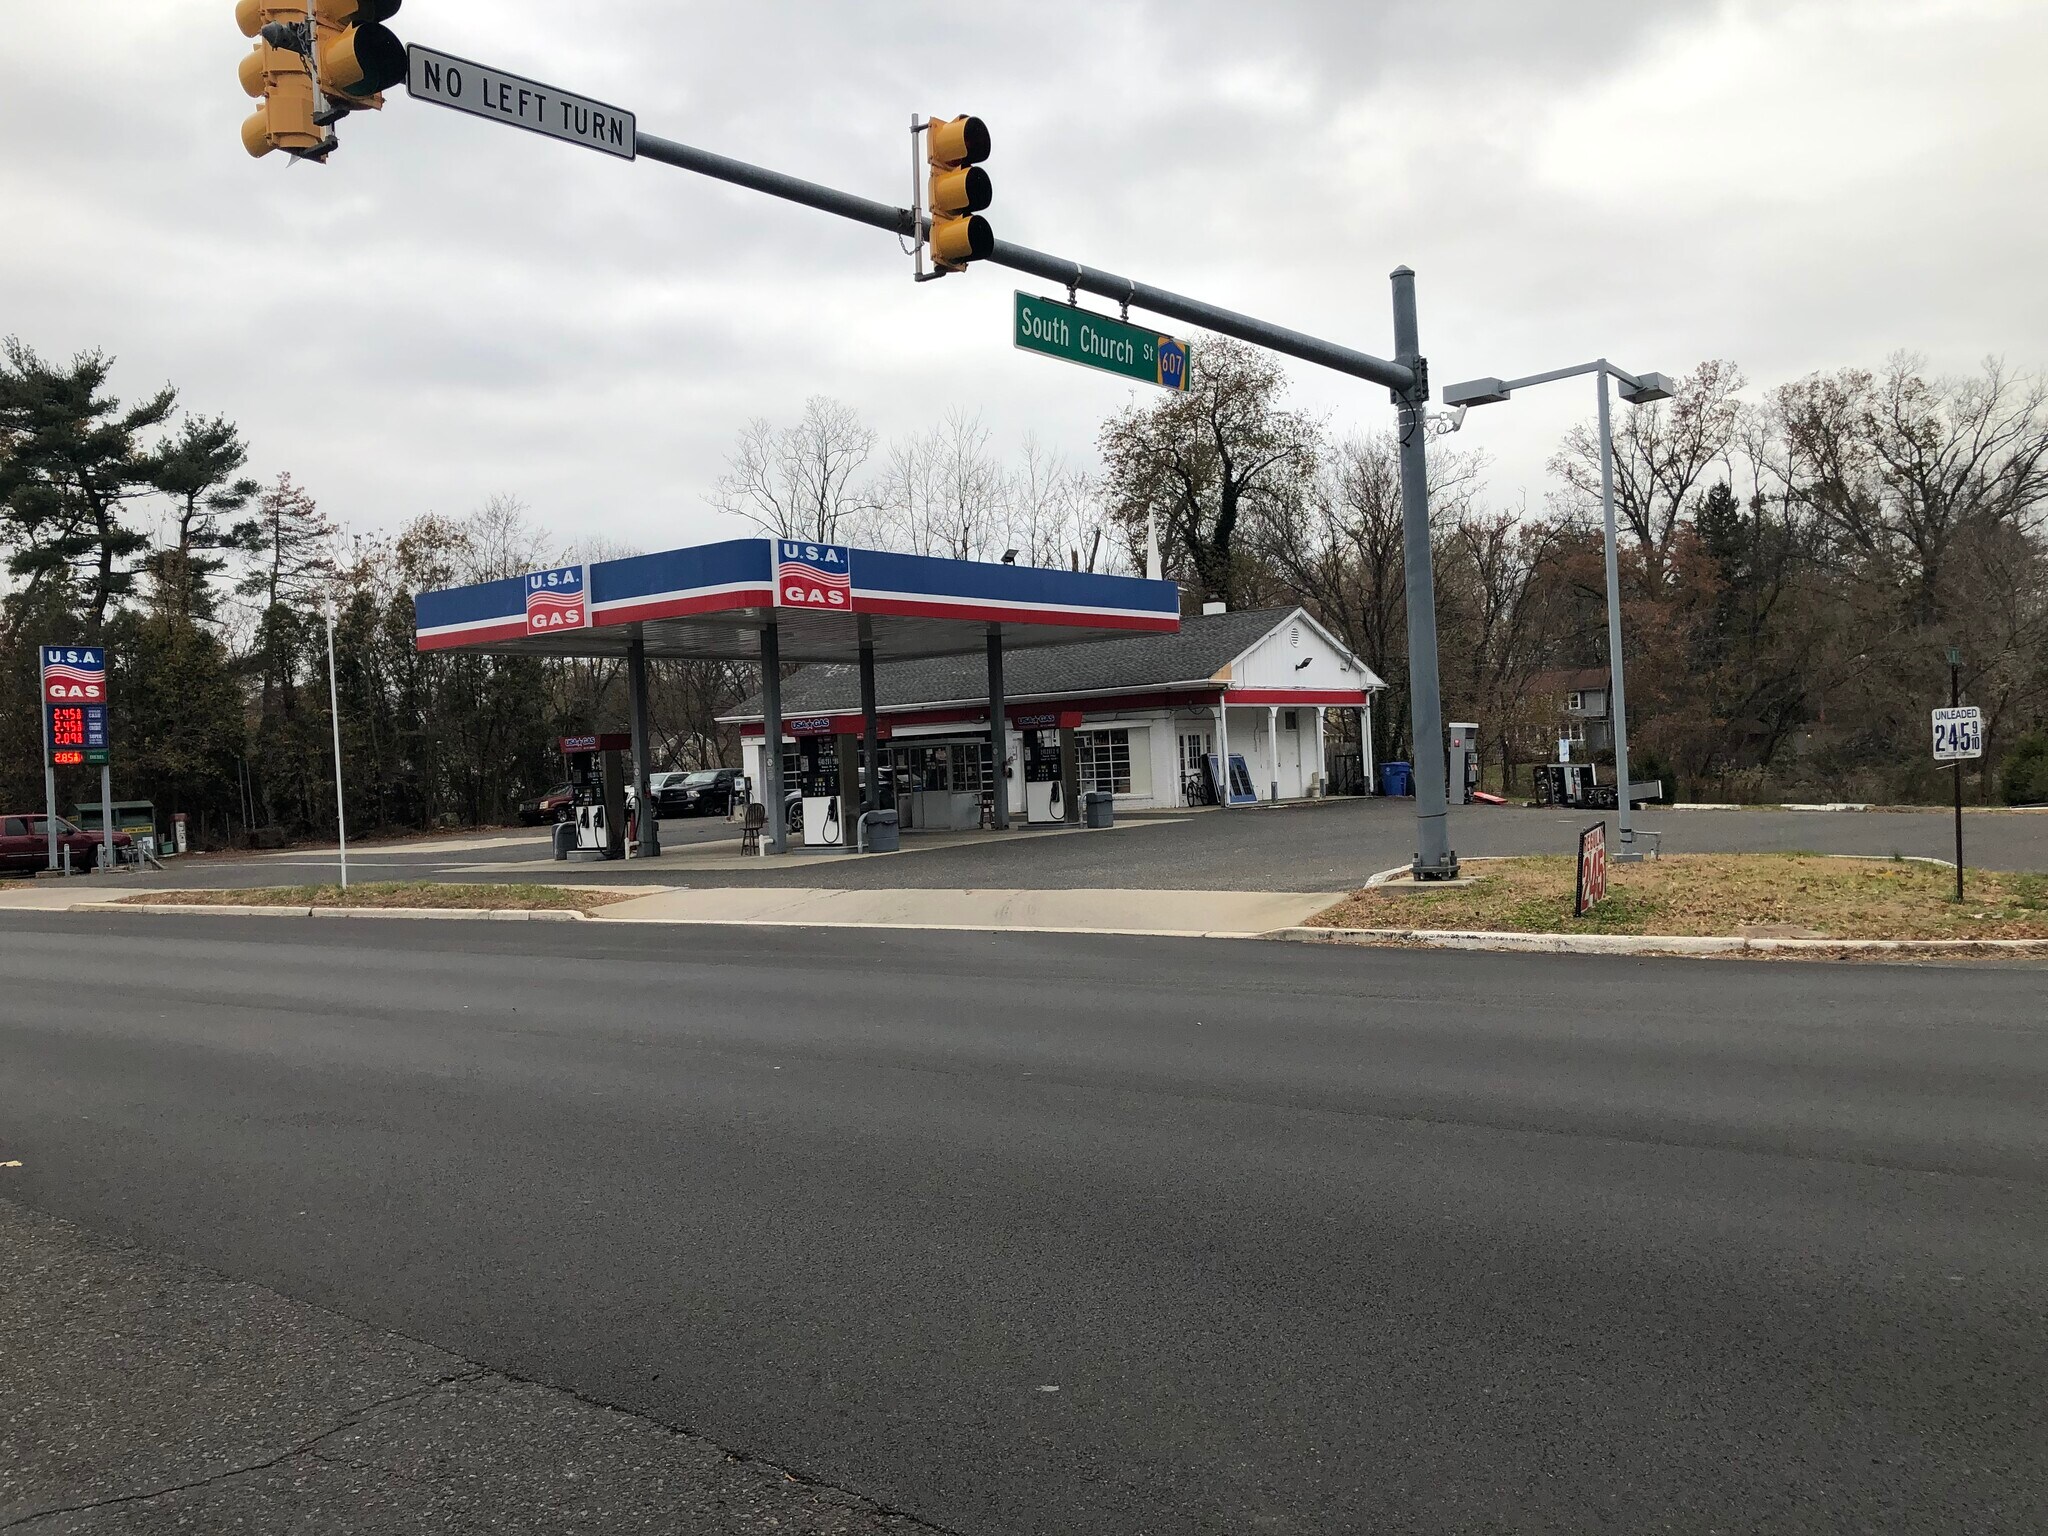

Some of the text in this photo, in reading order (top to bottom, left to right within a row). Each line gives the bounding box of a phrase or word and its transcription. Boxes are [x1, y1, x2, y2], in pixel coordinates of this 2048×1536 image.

[424, 60, 623, 146] NO LEFT TURN
[1021, 307, 1154, 365] South Church St
[1162, 352, 1182, 375] 607
[783, 543, 844, 563] U.S.A.
[530, 570, 580, 589] U.S.A.
[785, 586, 844, 605] GAS
[532, 609, 580, 628] GAS
[48, 650, 100, 663] U.S.A.
[50, 684, 100, 698] GAS
[791, 718, 830, 730] USA GAS
[1935, 709, 1977, 720] UNLEADED
[1935, 722, 1970, 752] 245
[1581, 849, 1604, 911] 245
